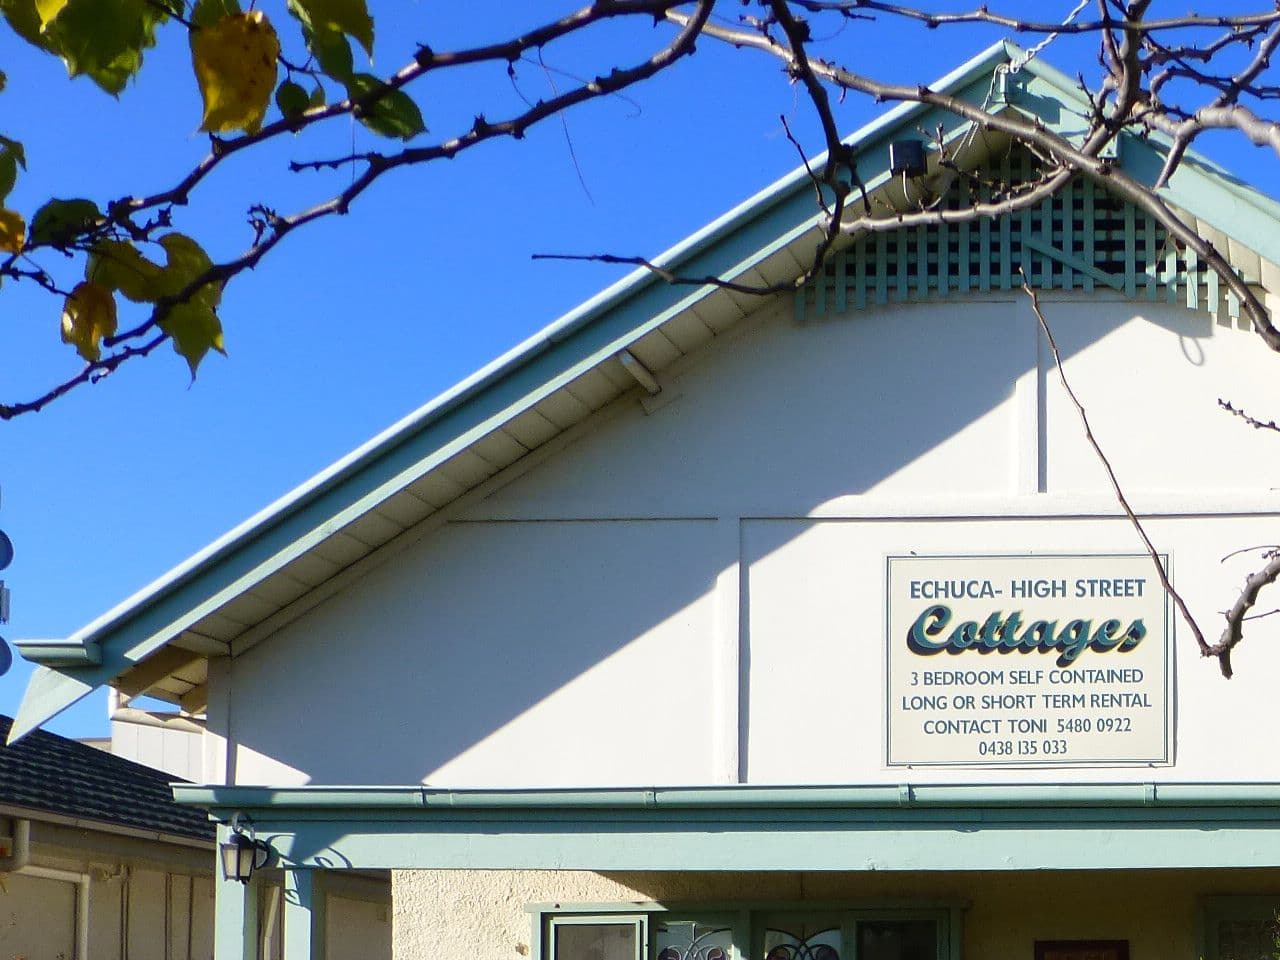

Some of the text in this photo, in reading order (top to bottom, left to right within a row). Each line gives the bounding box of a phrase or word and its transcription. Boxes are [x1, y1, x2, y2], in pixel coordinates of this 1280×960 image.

[1011, 579, 1067, 599] HIGH
[1075, 578, 1146, 598] STREET
[907, 604, 1147, 668] Cottages
[911, 669, 1144, 686] 3 BEDROOM SELF CONTAINED
[902, 693, 1152, 711] LONG OR SHORT TERM RENTAL
[923, 717, 1132, 735] CONTACT TONI 5480 0922
[978, 740, 1068, 756] 0438 135 033
